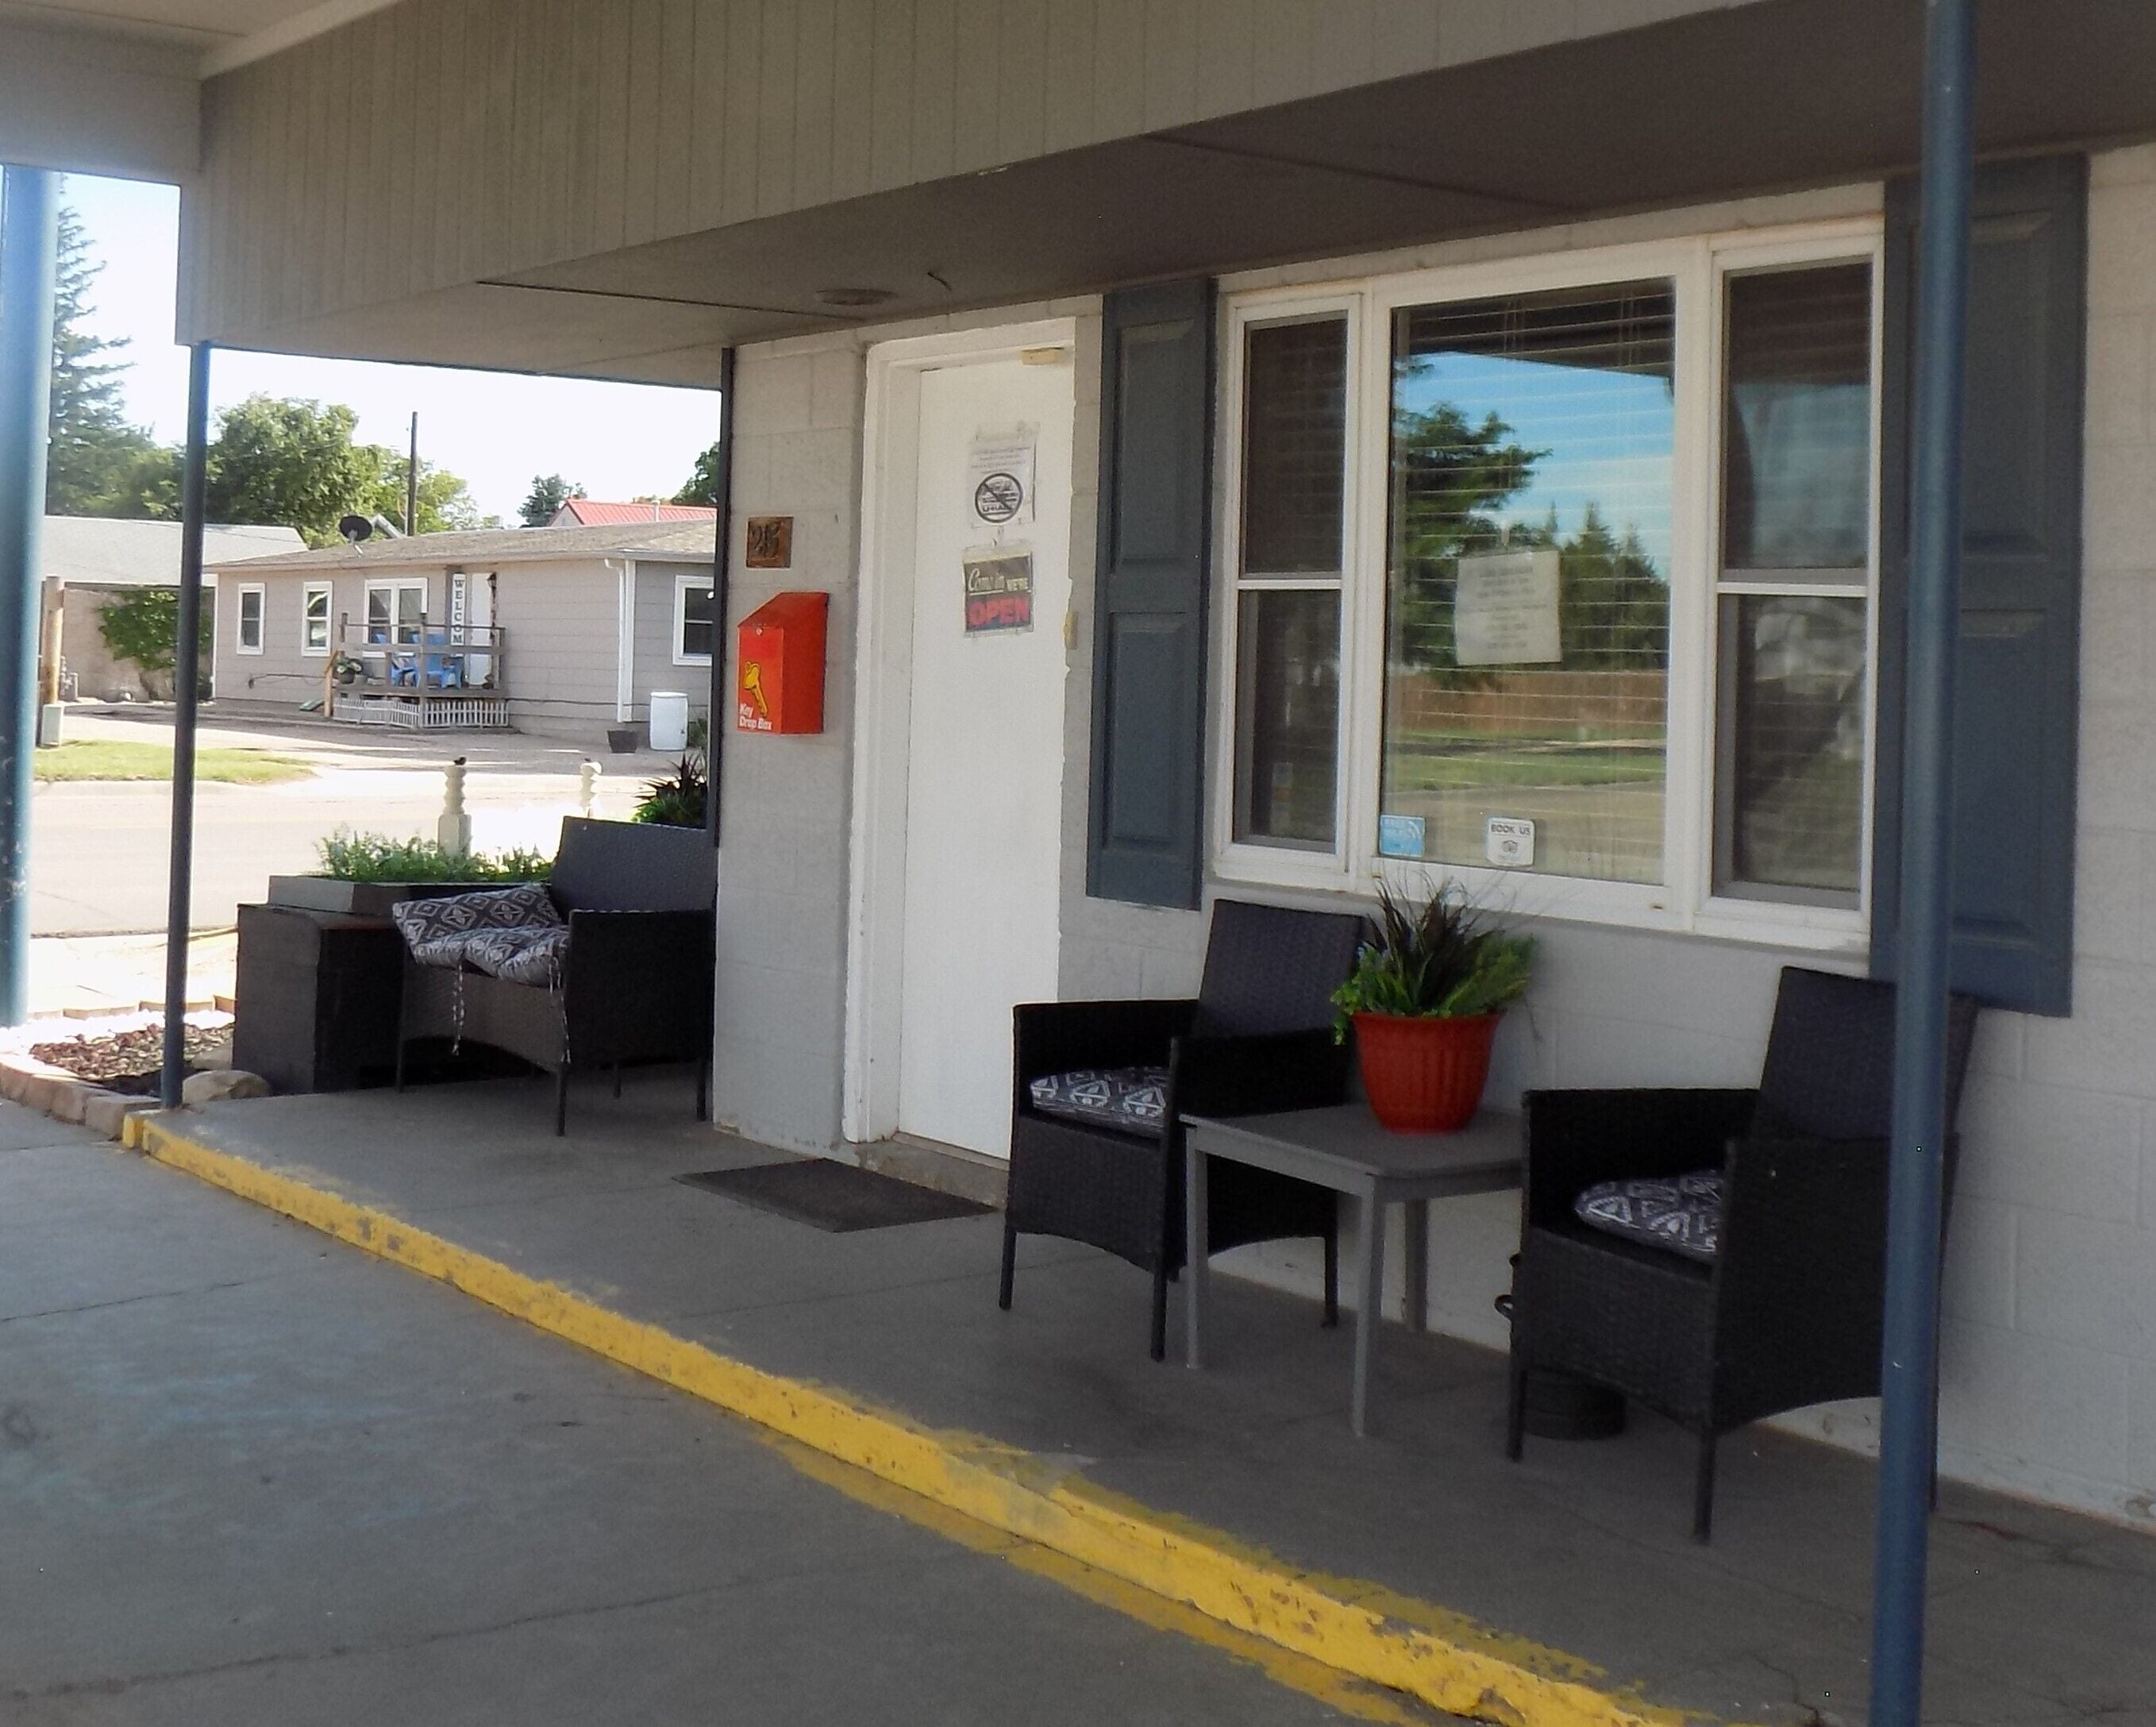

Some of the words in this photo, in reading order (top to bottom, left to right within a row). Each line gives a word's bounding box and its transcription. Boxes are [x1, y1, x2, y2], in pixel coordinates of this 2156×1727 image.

[452, 579, 465, 644] WELCOM
[969, 598, 1030, 626] OPEN
[739, 703, 753, 718] Key
[739, 715, 757, 731] Drop
[757, 718, 773, 731] Box
[1491, 823, 1515, 834] BOOK
[1519, 826, 1531, 835] US
